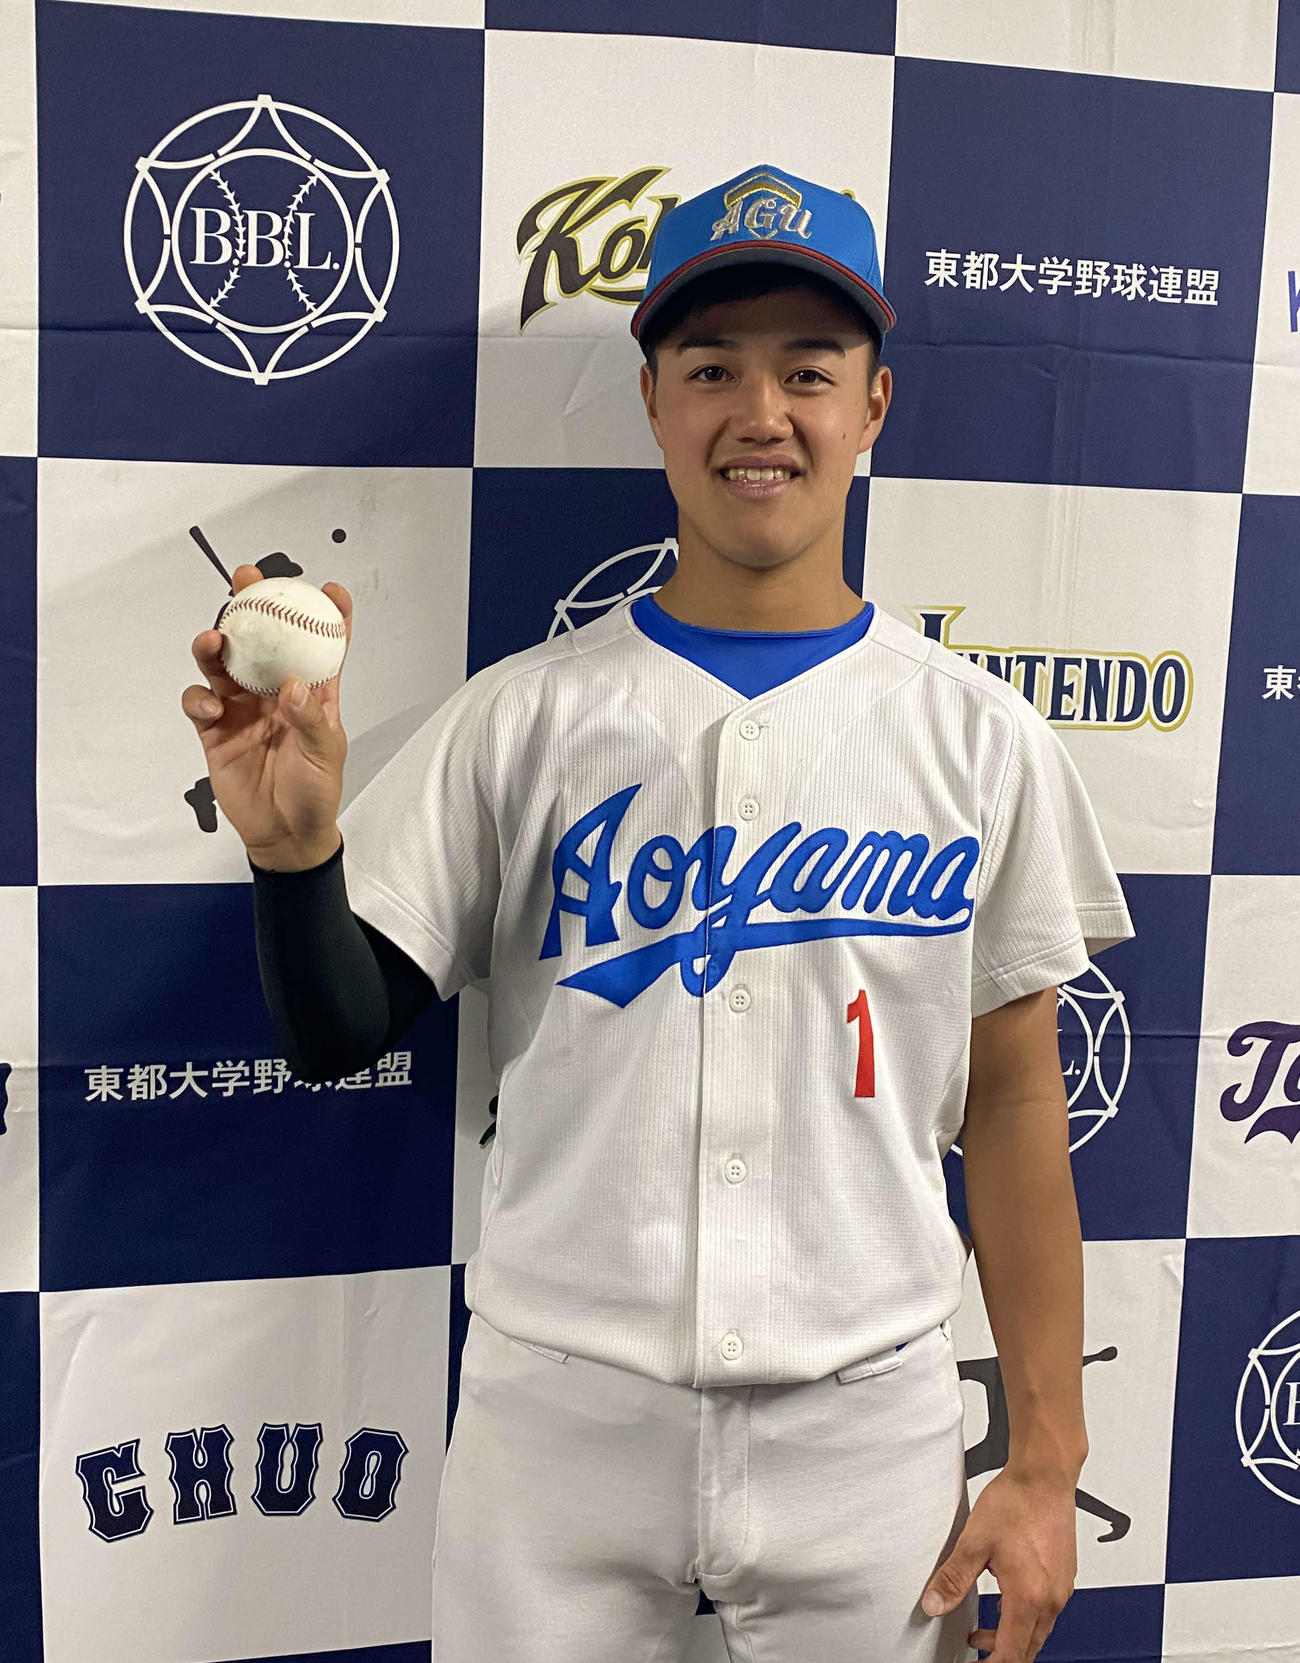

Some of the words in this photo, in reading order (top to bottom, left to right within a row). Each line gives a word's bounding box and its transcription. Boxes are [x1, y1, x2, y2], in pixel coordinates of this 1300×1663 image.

[710, 198, 813, 241] AGU
[924, 248, 1220, 306] 東都大学野球連盟
[539, 783, 980, 1000] Aoyama
[846, 988, 876, 1098] 1
[76, 1422, 409, 1544] CHUO
